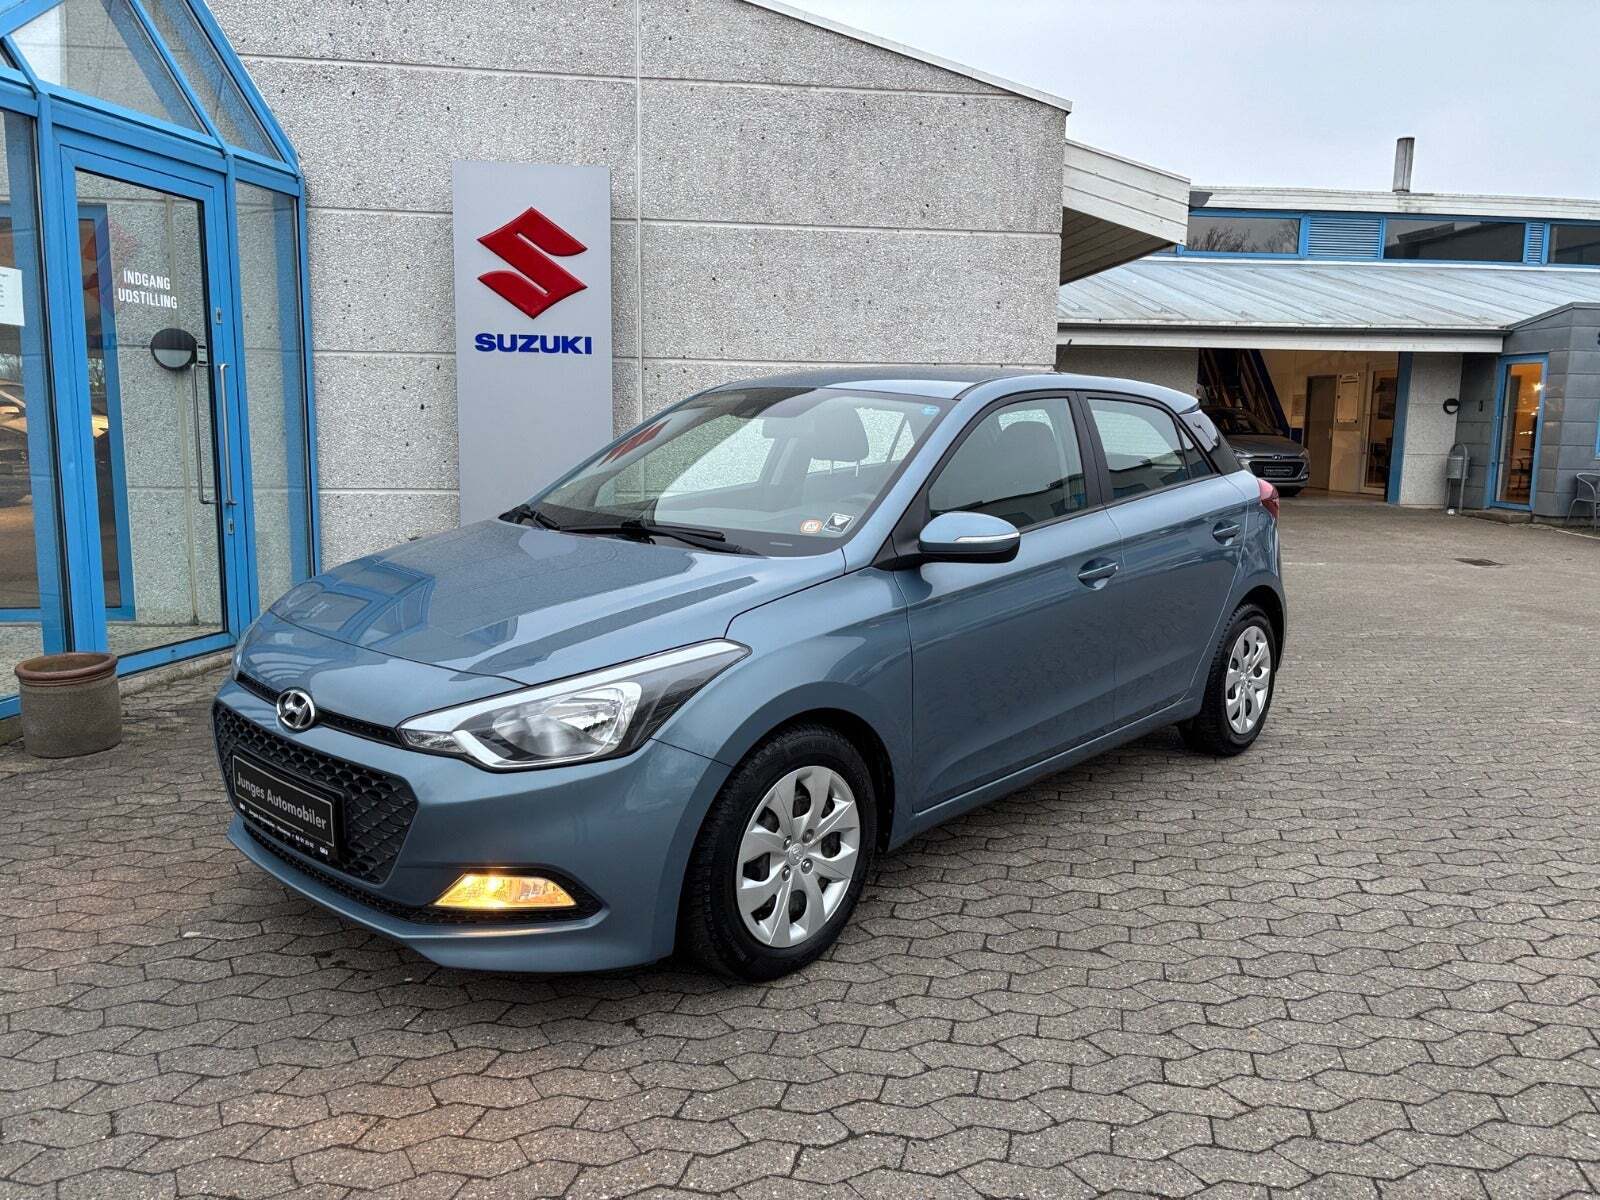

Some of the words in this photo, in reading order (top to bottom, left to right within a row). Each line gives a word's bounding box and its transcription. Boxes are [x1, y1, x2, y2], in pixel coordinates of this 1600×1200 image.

[123, 269, 171, 290] INDGANG
[118, 287, 178, 309] UDSTILLING
[474, 332, 593, 355] SUZUKI
[237, 772, 265, 800] Junges
[266, 788, 327, 830] Automobiler
